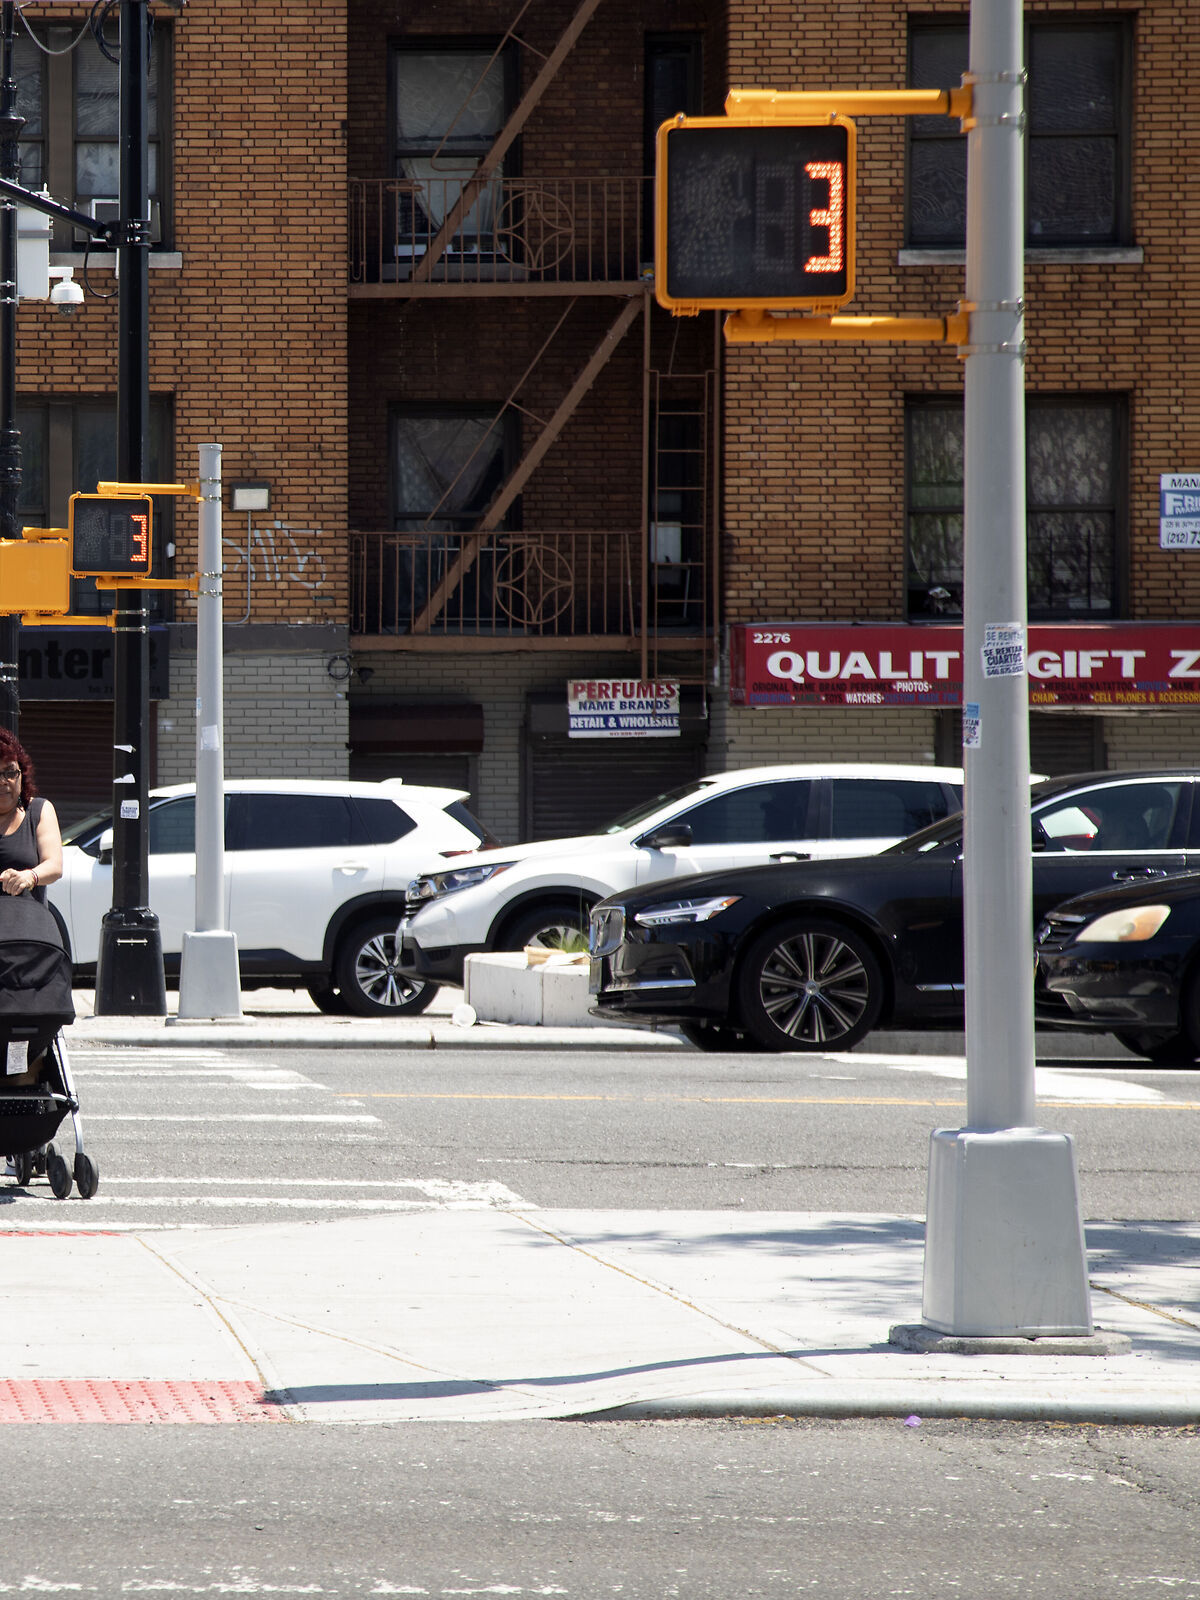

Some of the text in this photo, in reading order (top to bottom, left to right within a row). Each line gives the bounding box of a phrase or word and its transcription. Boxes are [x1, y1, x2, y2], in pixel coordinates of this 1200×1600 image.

[805, 162, 843, 273] 3
[130, 513, 147, 562] 3
[753, 633, 791, 644] 2276
[983, 648, 995, 658] SE
[987, 653, 1022, 666] CUARTOS
[18, 640, 111, 680] nter
[766, 651, 961, 684] QUALIT
[1027, 650, 1146, 679] GIFT
[573, 681, 677, 700] PERFUMES
[819, 682, 847, 692] BRAND
[896, 681, 929, 692] PHOTOS
[846, 692, 882, 704] WATCHES
[1032, 692, 1056, 703] CHAIN
[1094, 692, 1112, 703] CELL
[578, 700, 670, 711] NAME BRANDS
[570, 716, 679, 729] RETAIL & WHOLESALE
